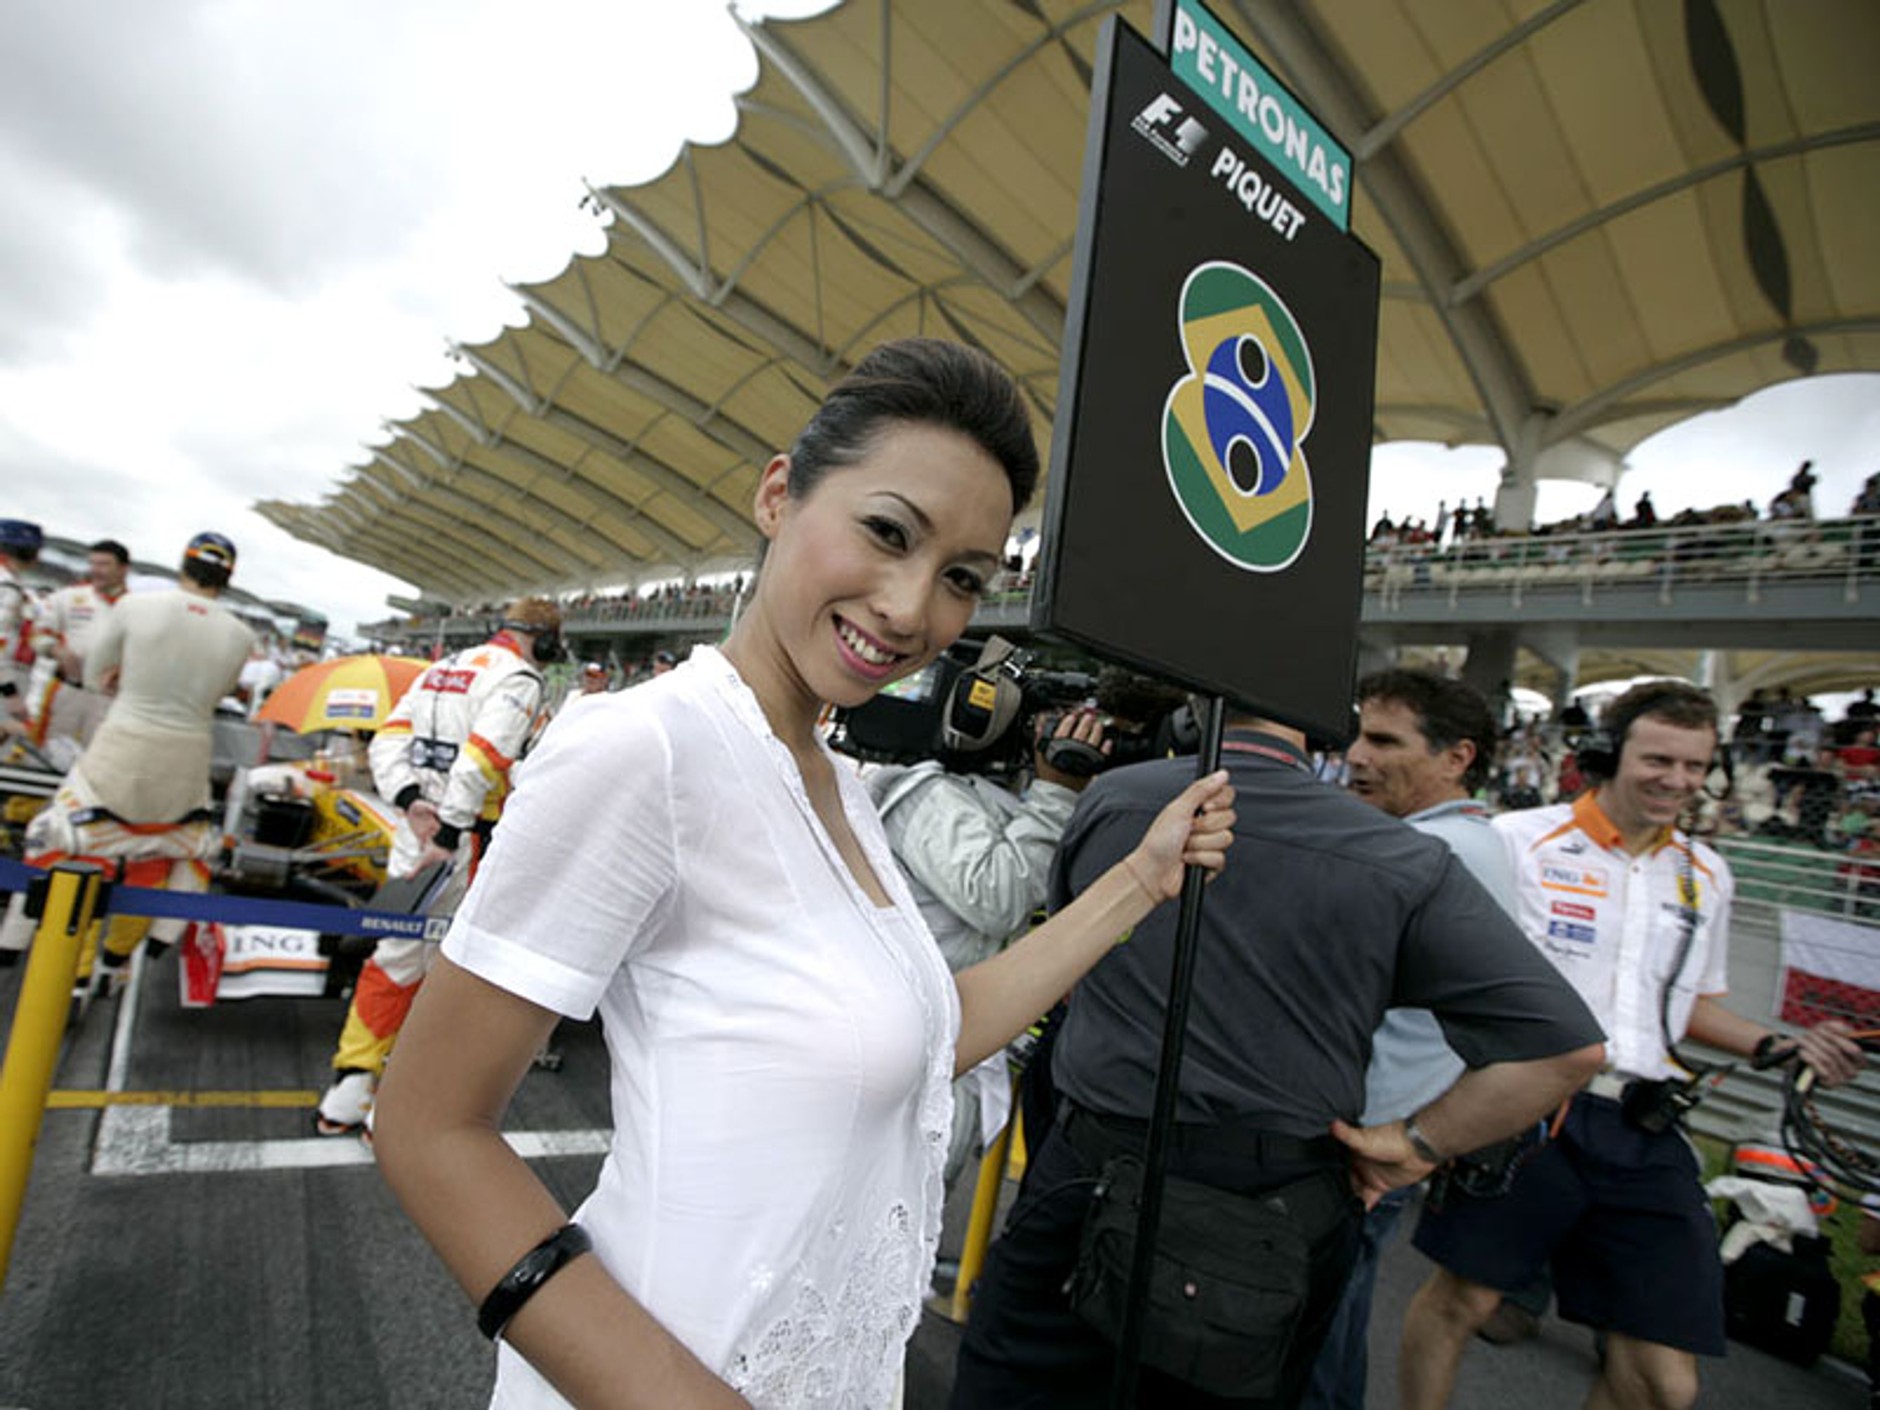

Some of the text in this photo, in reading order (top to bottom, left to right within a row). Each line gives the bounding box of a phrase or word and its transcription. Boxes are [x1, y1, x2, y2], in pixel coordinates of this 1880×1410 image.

[1141, 92, 1209, 155] F1
[1173, 6, 1345, 205] PETRONAS
[1211, 147, 1306, 241] PIQUET
[1161, 260, 1316, 572] 8
[234, 932, 304, 953] ING
[361, 917, 423, 934] RENAULT
